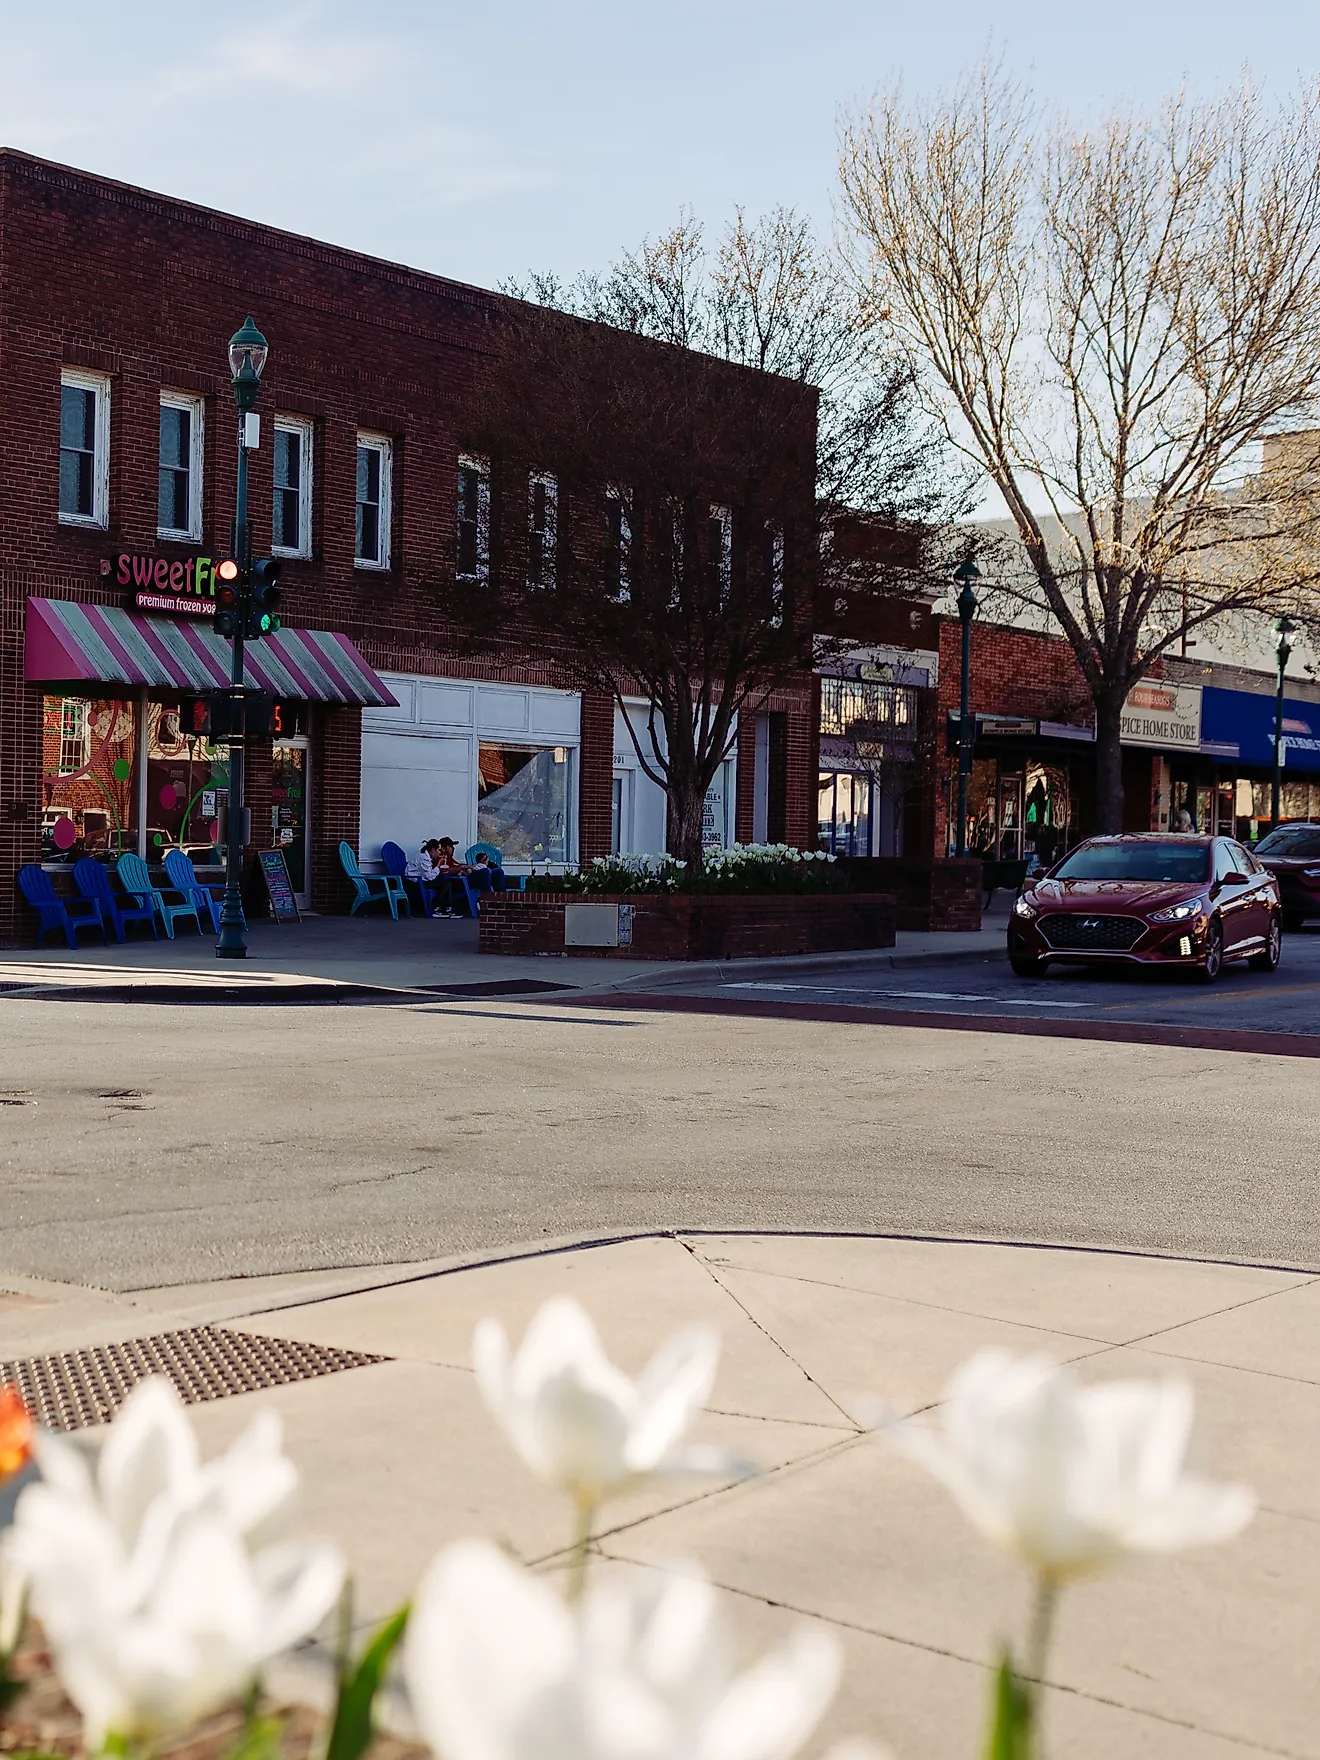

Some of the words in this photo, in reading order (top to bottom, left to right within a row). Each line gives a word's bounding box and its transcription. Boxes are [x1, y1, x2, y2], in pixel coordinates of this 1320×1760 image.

[138, 594, 175, 610] premium
[176, 597, 202, 613] frozen
[1121, 717, 1142, 735] PICE
[1143, 719, 1169, 738] HOME
[1170, 722, 1197, 740] STORE
